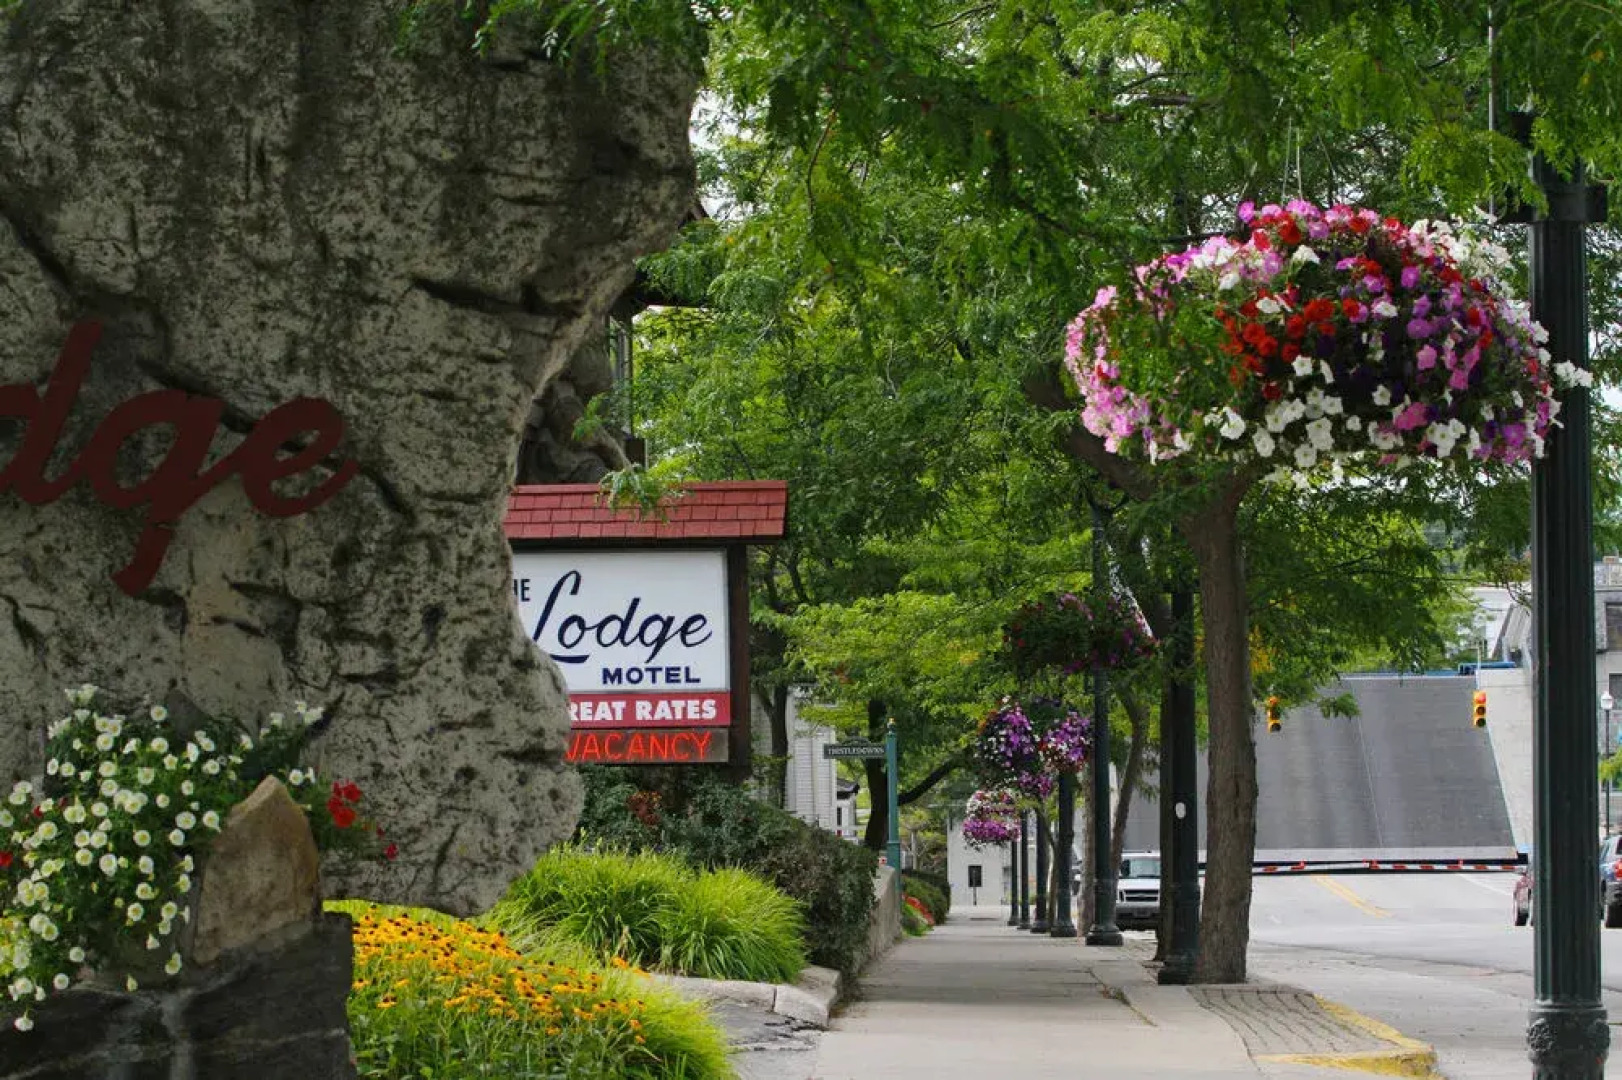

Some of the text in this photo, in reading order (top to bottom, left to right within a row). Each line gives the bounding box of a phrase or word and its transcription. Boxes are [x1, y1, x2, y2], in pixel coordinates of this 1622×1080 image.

[0, 320, 359, 597] dge
[533, 570, 713, 664] Lodge
[602, 666, 702, 685] MOTEL
[568, 698, 717, 721] REAT RATES
[564, 729, 713, 761] VACANCY
